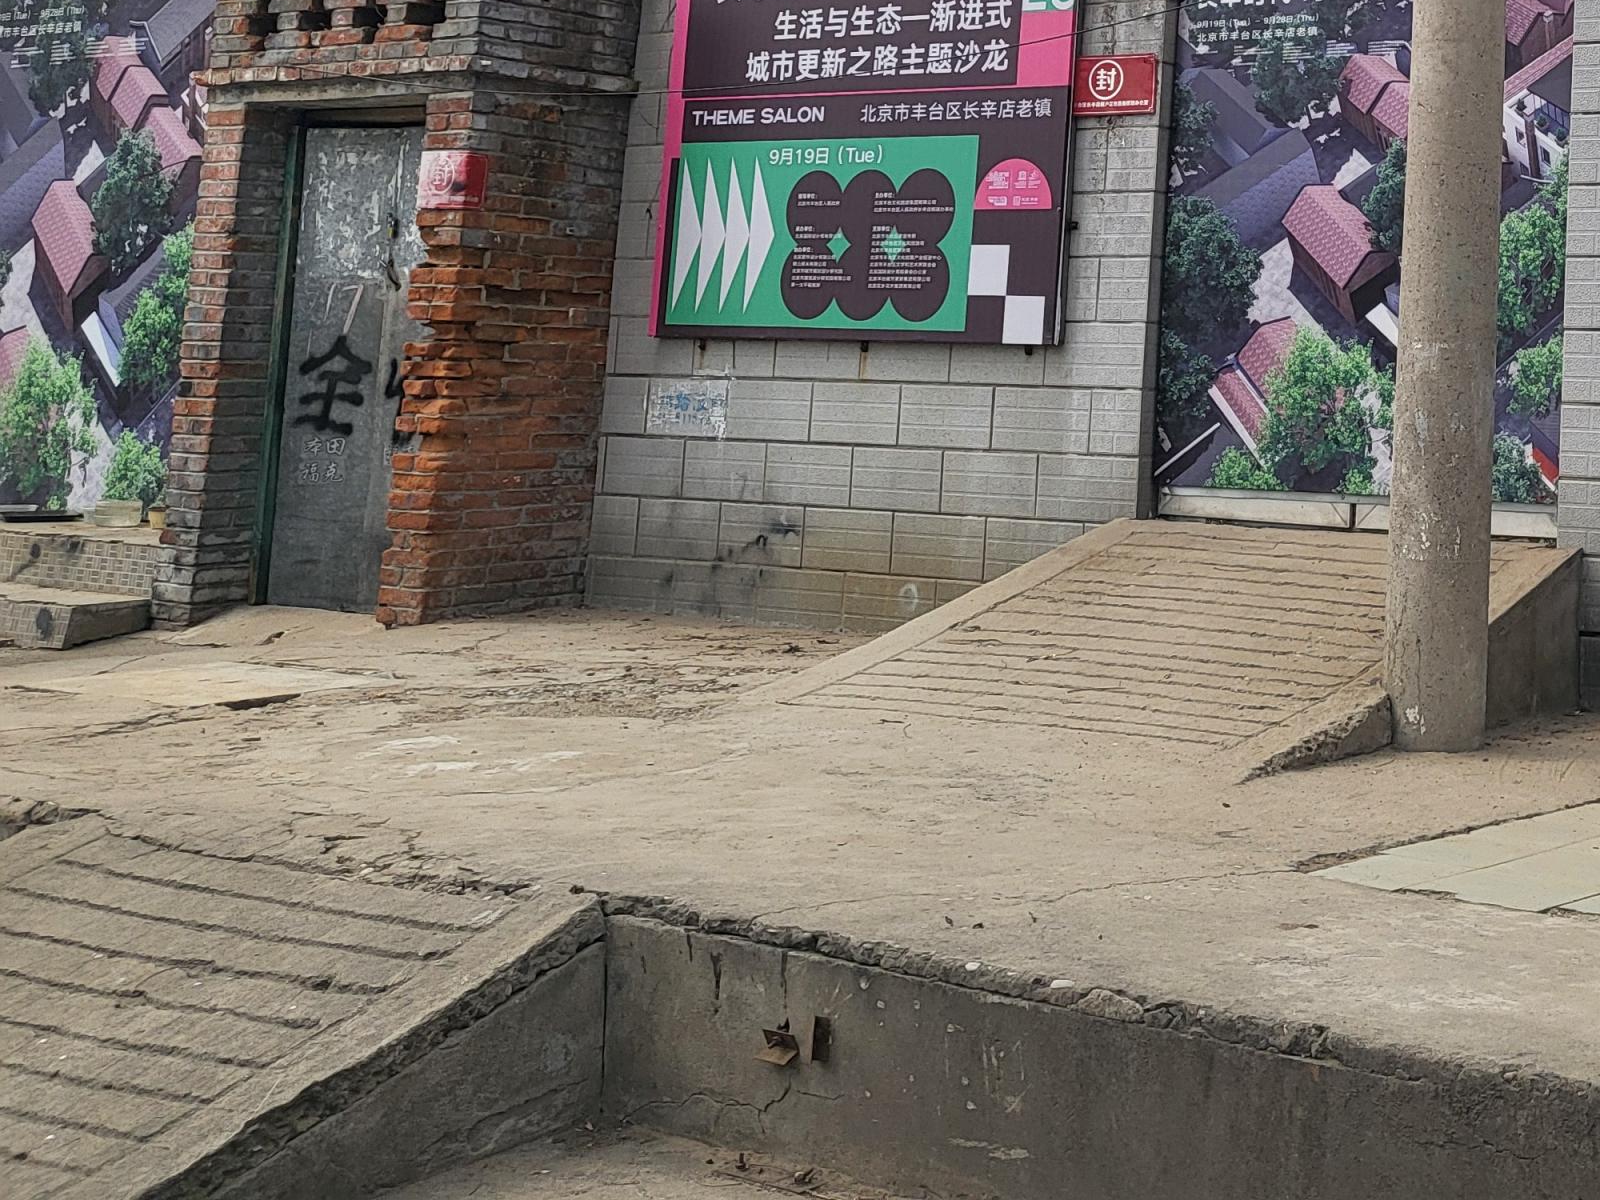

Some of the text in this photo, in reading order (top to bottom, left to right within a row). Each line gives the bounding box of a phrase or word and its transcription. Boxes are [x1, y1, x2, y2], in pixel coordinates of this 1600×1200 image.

[1197, 26, 1318, 42] 北京市丰台区长辛店老镇
[746, 38, 1009, 83] 城市更新之路主题沙龙
[1095, 67, 1118, 92] 封
[693, 107, 825, 127] THEME SALON
[860, 97, 1053, 123] 北京市丰台区长辛店老镇
